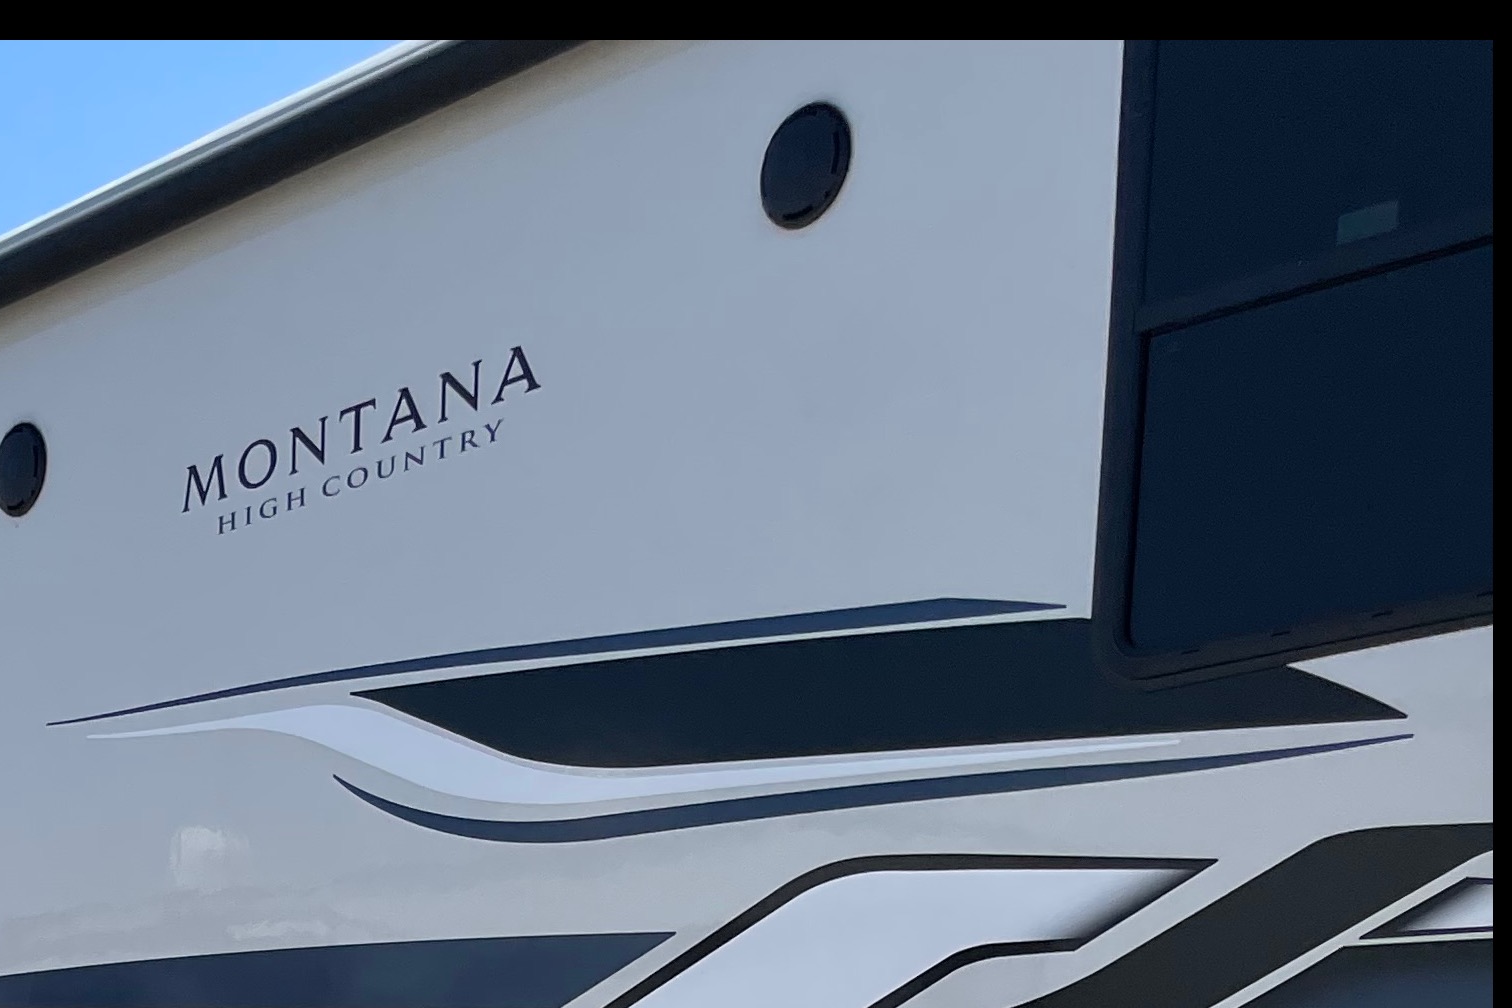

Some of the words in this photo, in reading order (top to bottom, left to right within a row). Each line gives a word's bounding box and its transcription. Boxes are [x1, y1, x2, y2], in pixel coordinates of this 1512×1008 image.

[180, 344, 542, 514] MONTANA
[216, 486, 308, 536] HIGH
[321, 417, 505, 498] COUNTRY
